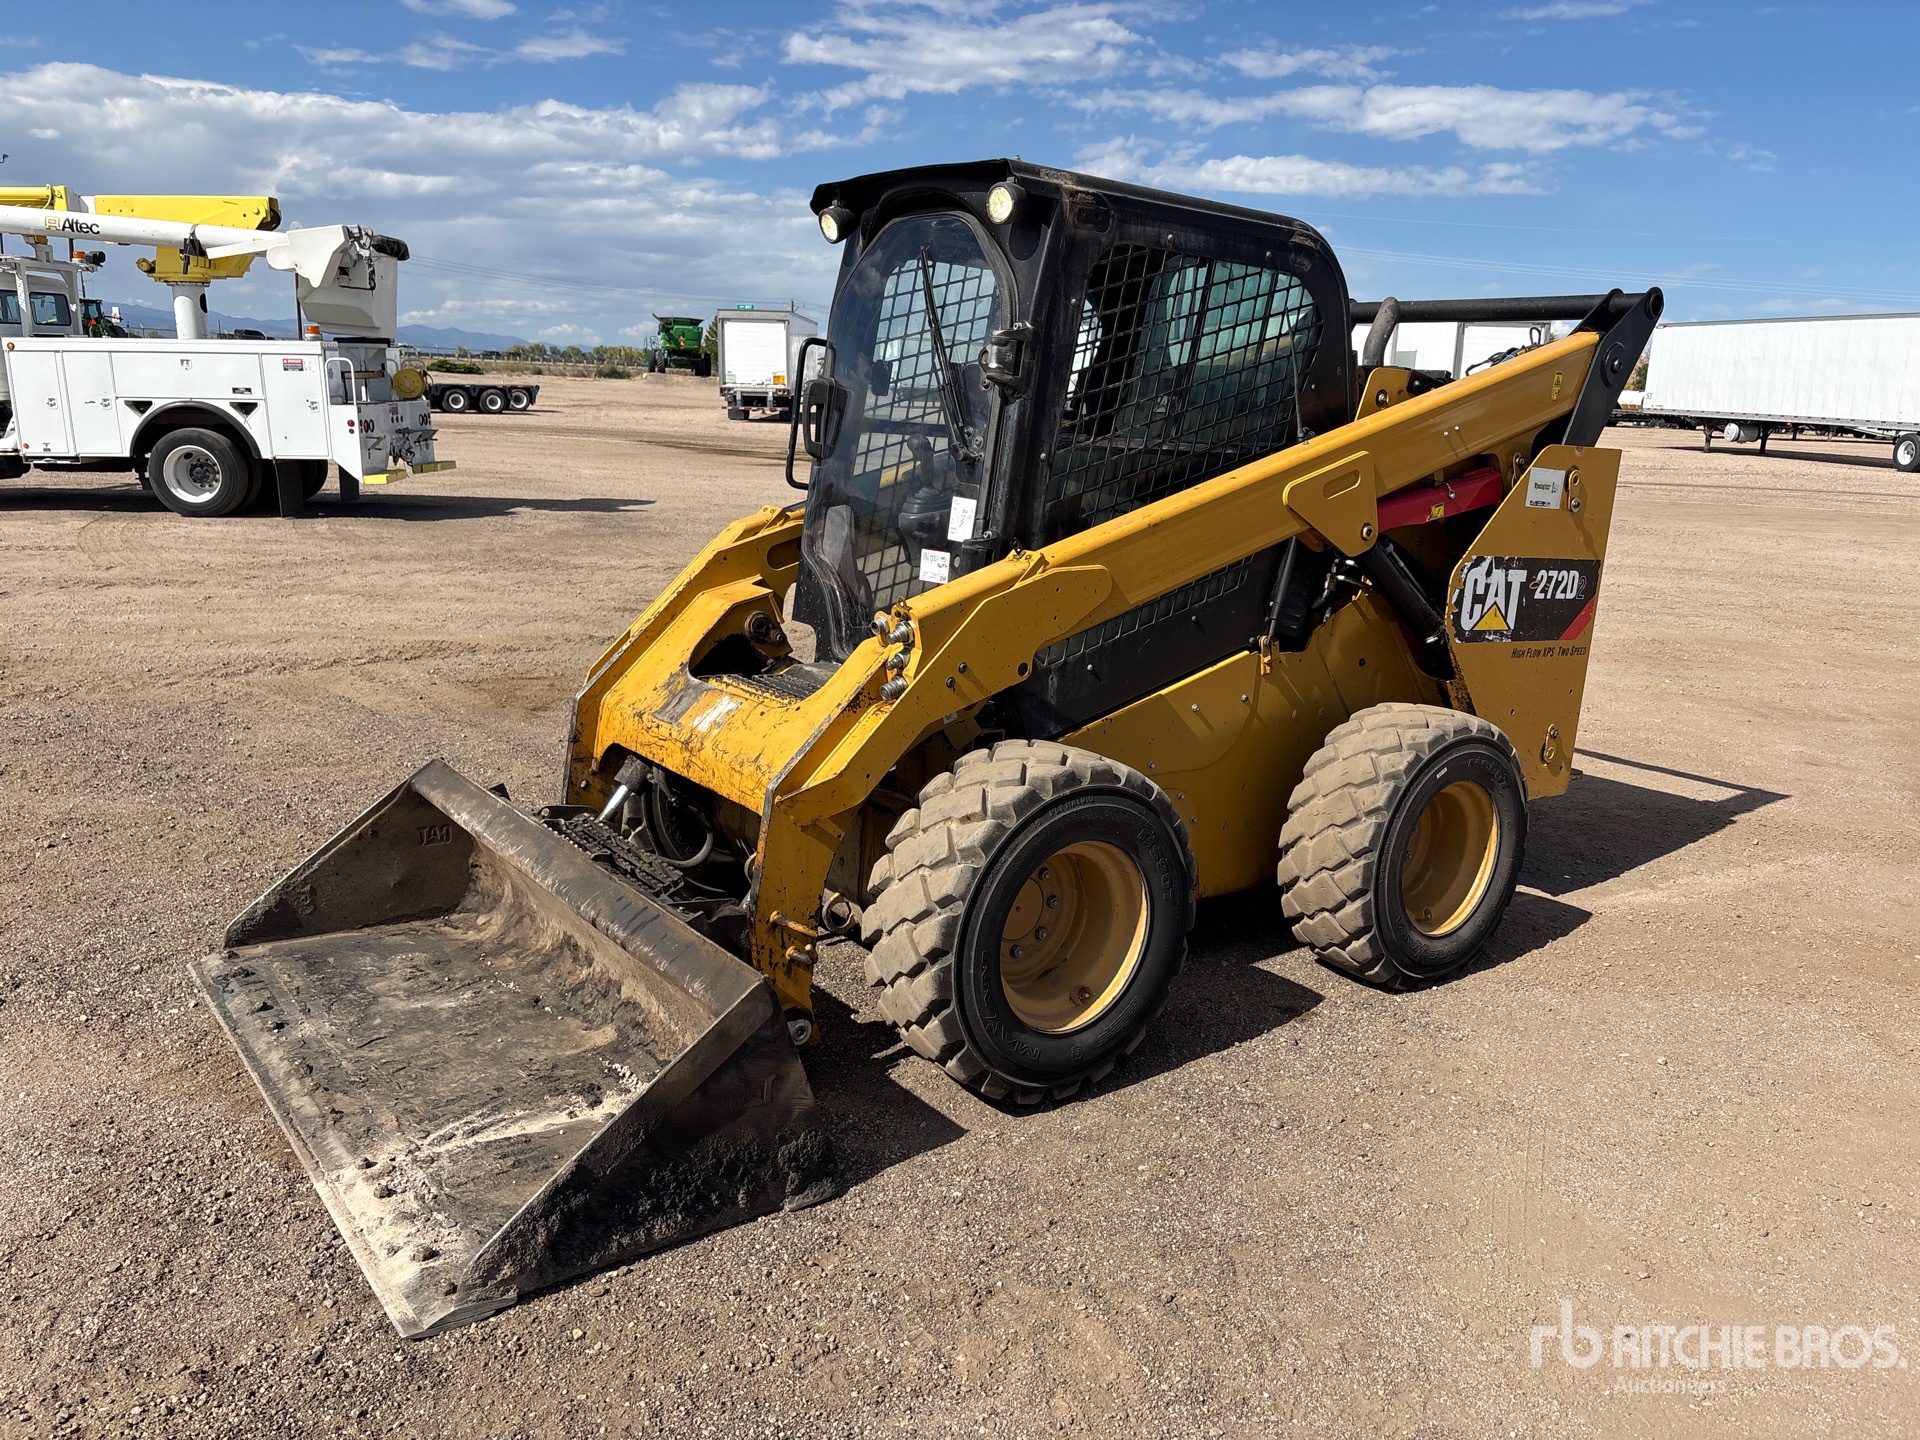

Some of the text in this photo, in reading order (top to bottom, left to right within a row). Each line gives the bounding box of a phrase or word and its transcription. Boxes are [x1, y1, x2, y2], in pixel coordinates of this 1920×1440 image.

[61, 217, 100, 235] Altec
[1460, 567, 1528, 631] CAT
[1542, 646, 1556, 658] XPS
